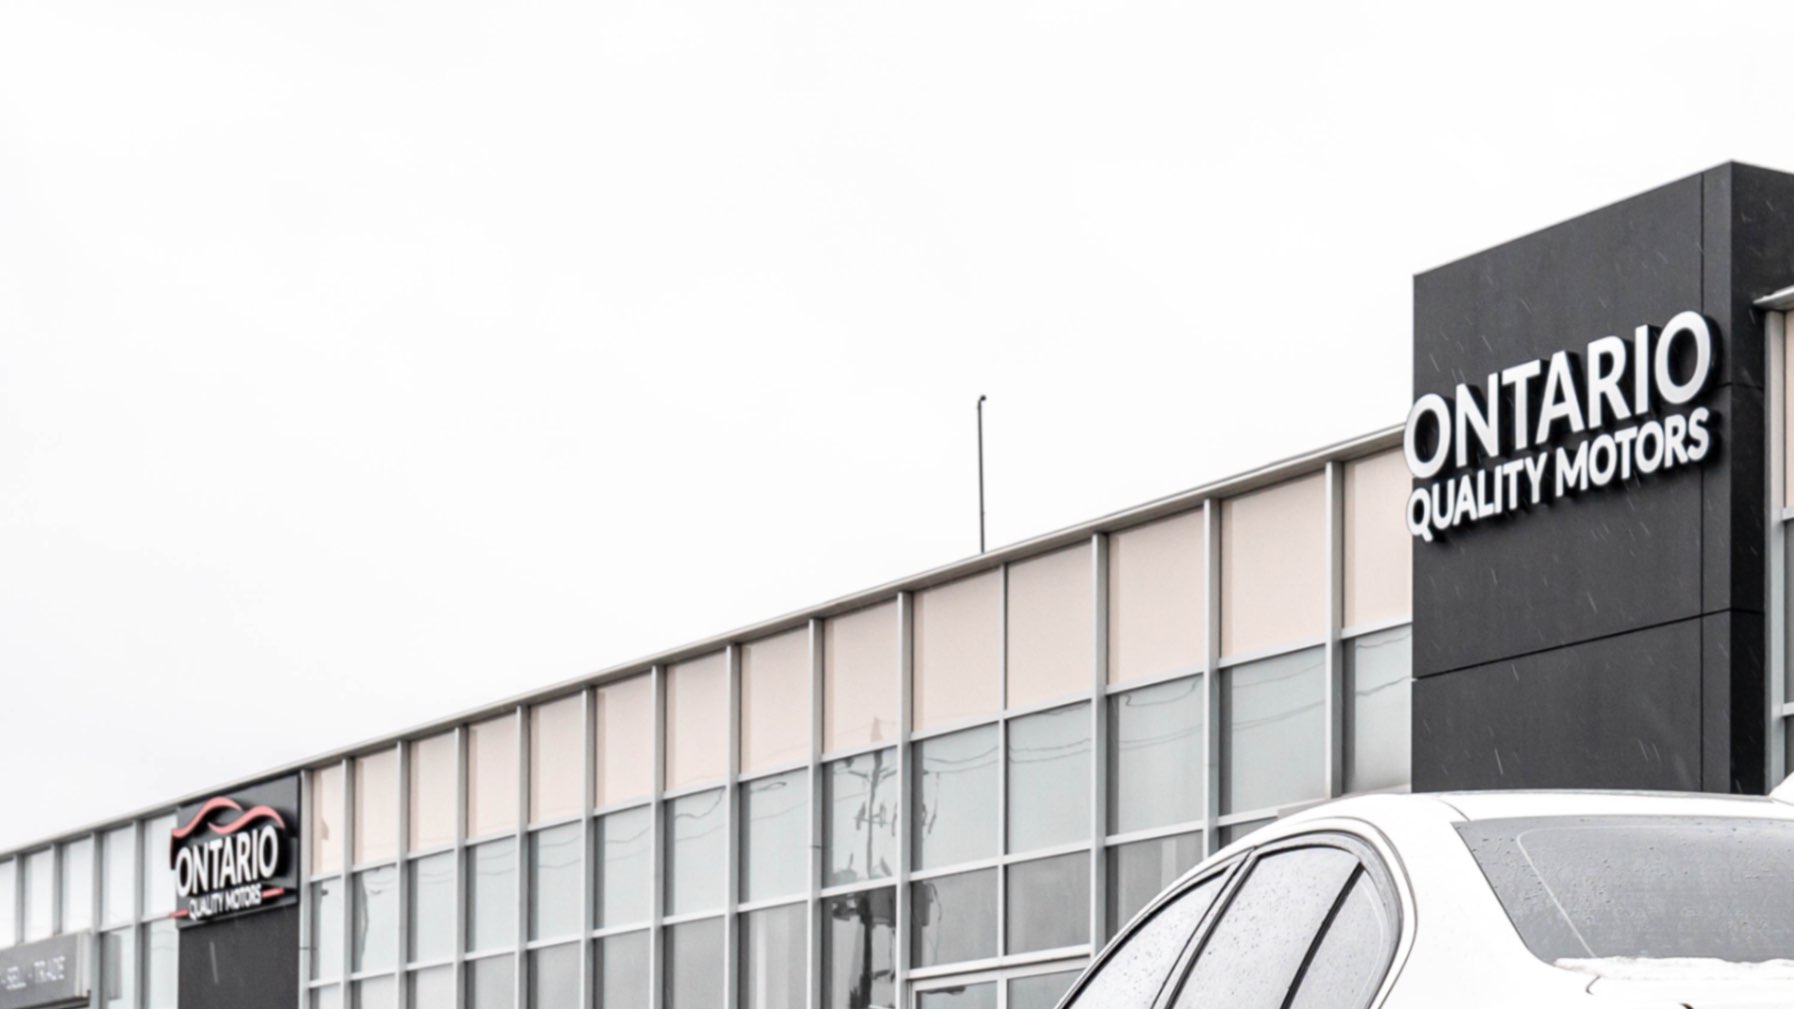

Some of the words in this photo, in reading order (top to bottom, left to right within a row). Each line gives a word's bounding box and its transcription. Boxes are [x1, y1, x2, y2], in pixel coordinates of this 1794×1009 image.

[1403, 310, 1712, 479] ONTARIO
[1405, 452, 1549, 542] QUALITY
[1555, 406, 1710, 498] MOTORS
[175, 825, 279, 898] ONTARIO
[189, 892, 225, 921] QUALITY
[225, 882, 262, 912] MOTORS
